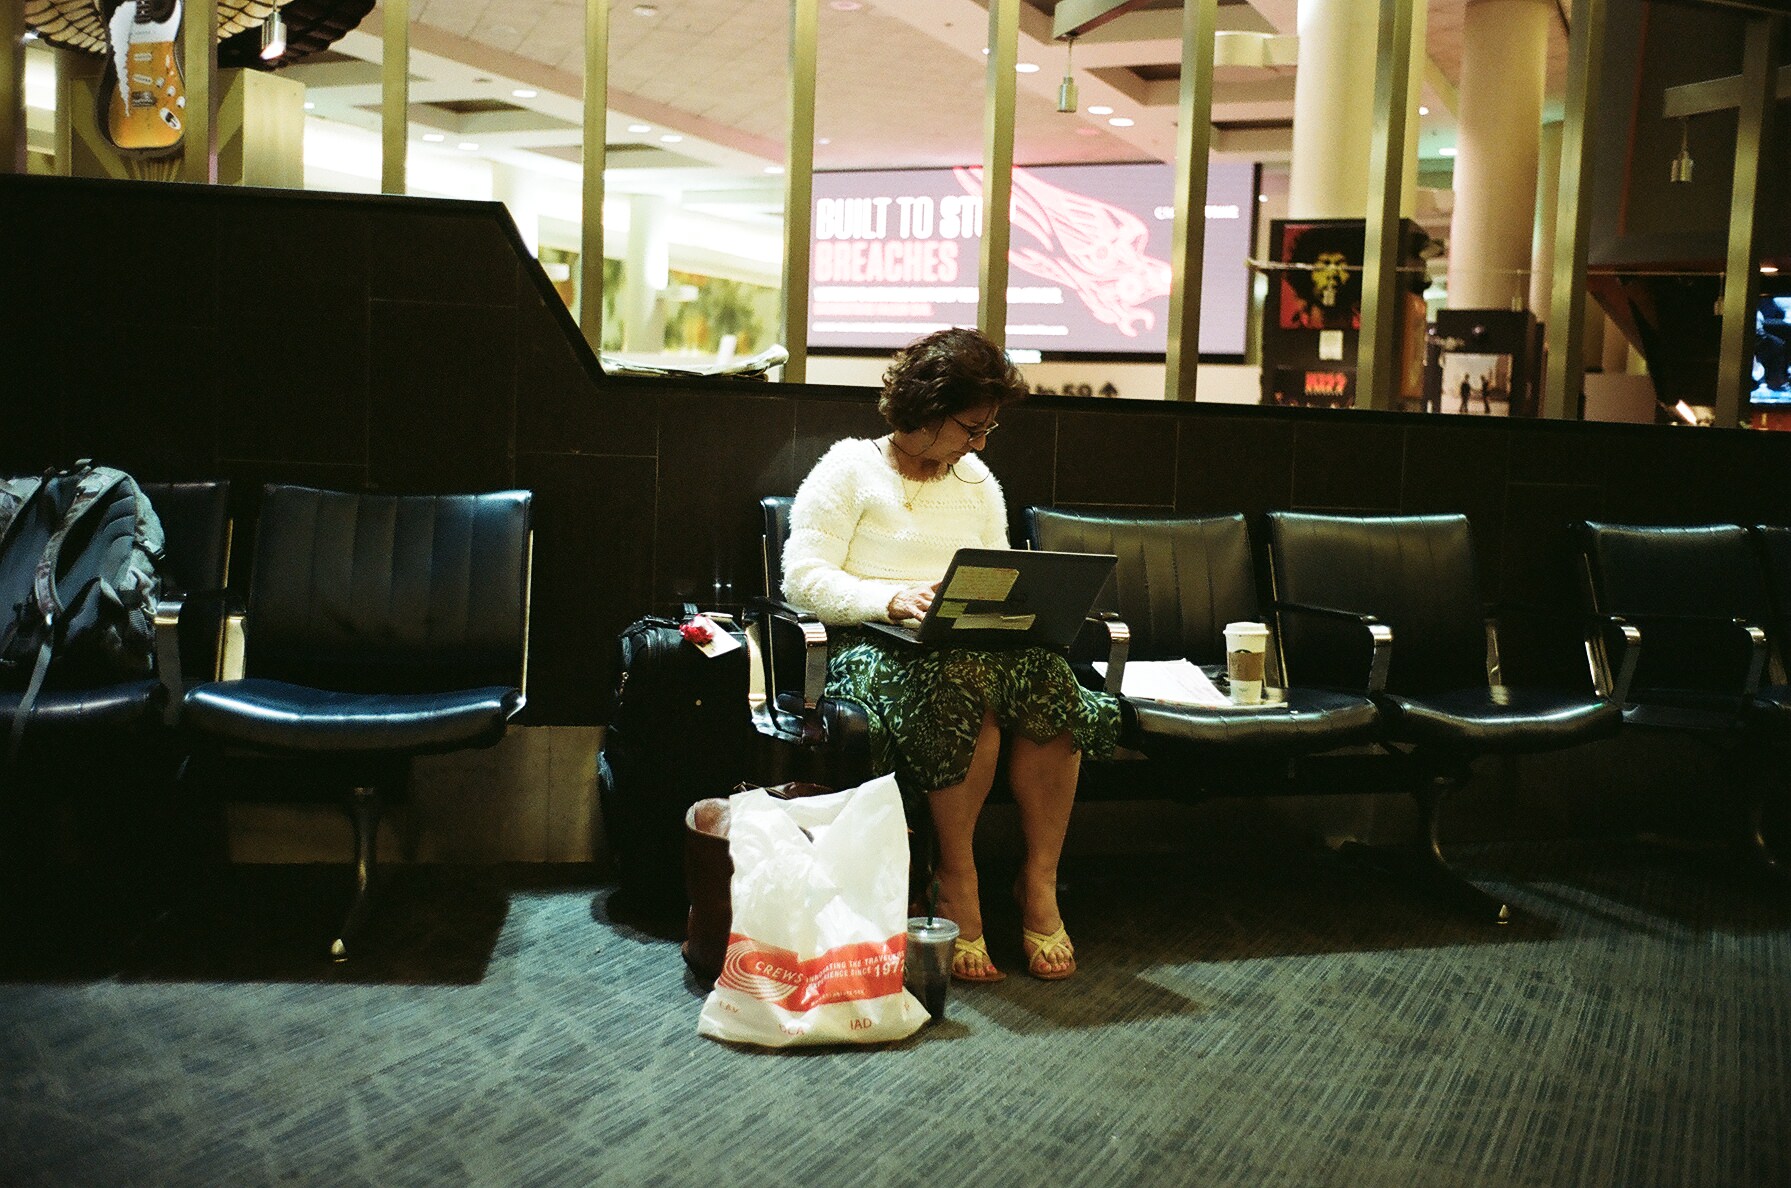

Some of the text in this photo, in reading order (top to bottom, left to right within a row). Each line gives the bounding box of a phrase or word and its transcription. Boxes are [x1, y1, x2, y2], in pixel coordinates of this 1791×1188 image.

[816, 197, 892, 239] BUILT
[896, 196, 934, 239] TO
[815, 240, 959, 282] BREACHES
[849, 959, 861, 968] THE
[851, 966, 871, 976] SINCE
[755, 961, 804, 984] CREWS
[850, 1018, 872, 1030] IAD
